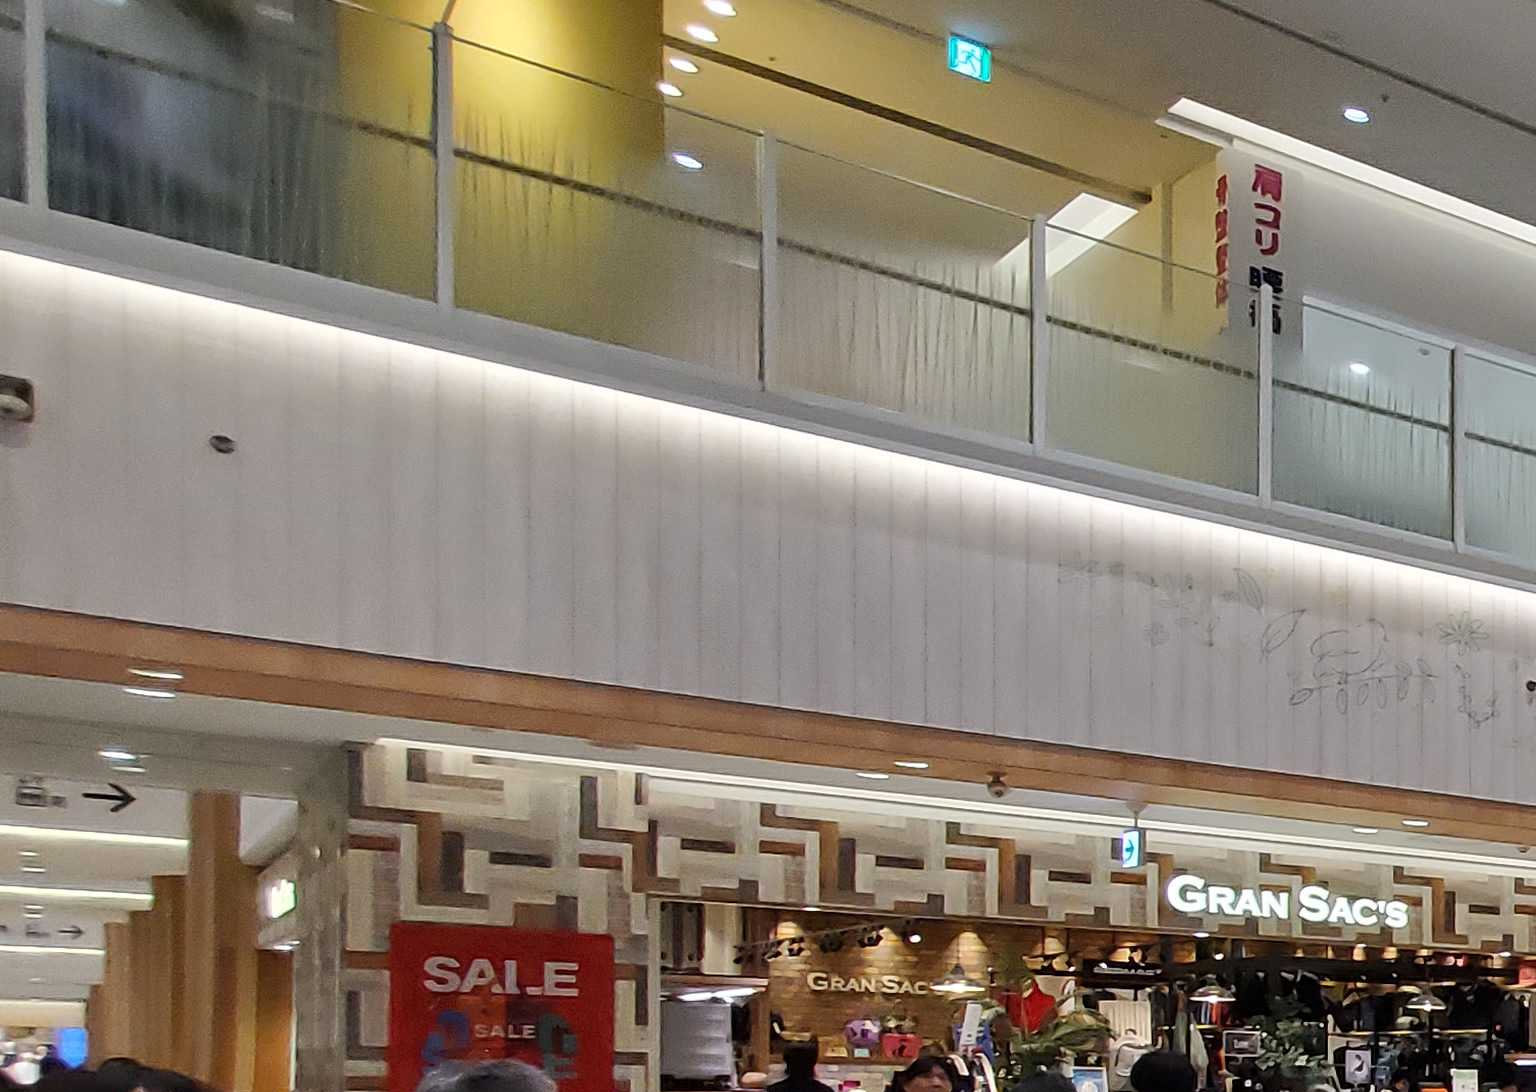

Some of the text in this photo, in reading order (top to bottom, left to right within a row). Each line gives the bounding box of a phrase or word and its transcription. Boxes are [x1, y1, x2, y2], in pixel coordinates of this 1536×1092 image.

[1252, 164, 1283, 256] 肩コリ
[1166, 874, 1409, 929] GRAN SAC'S
[423, 955, 580, 997] SALE
[806, 971, 946, 996] GRAN SAC'
[474, 1024, 536, 1039] SALE
